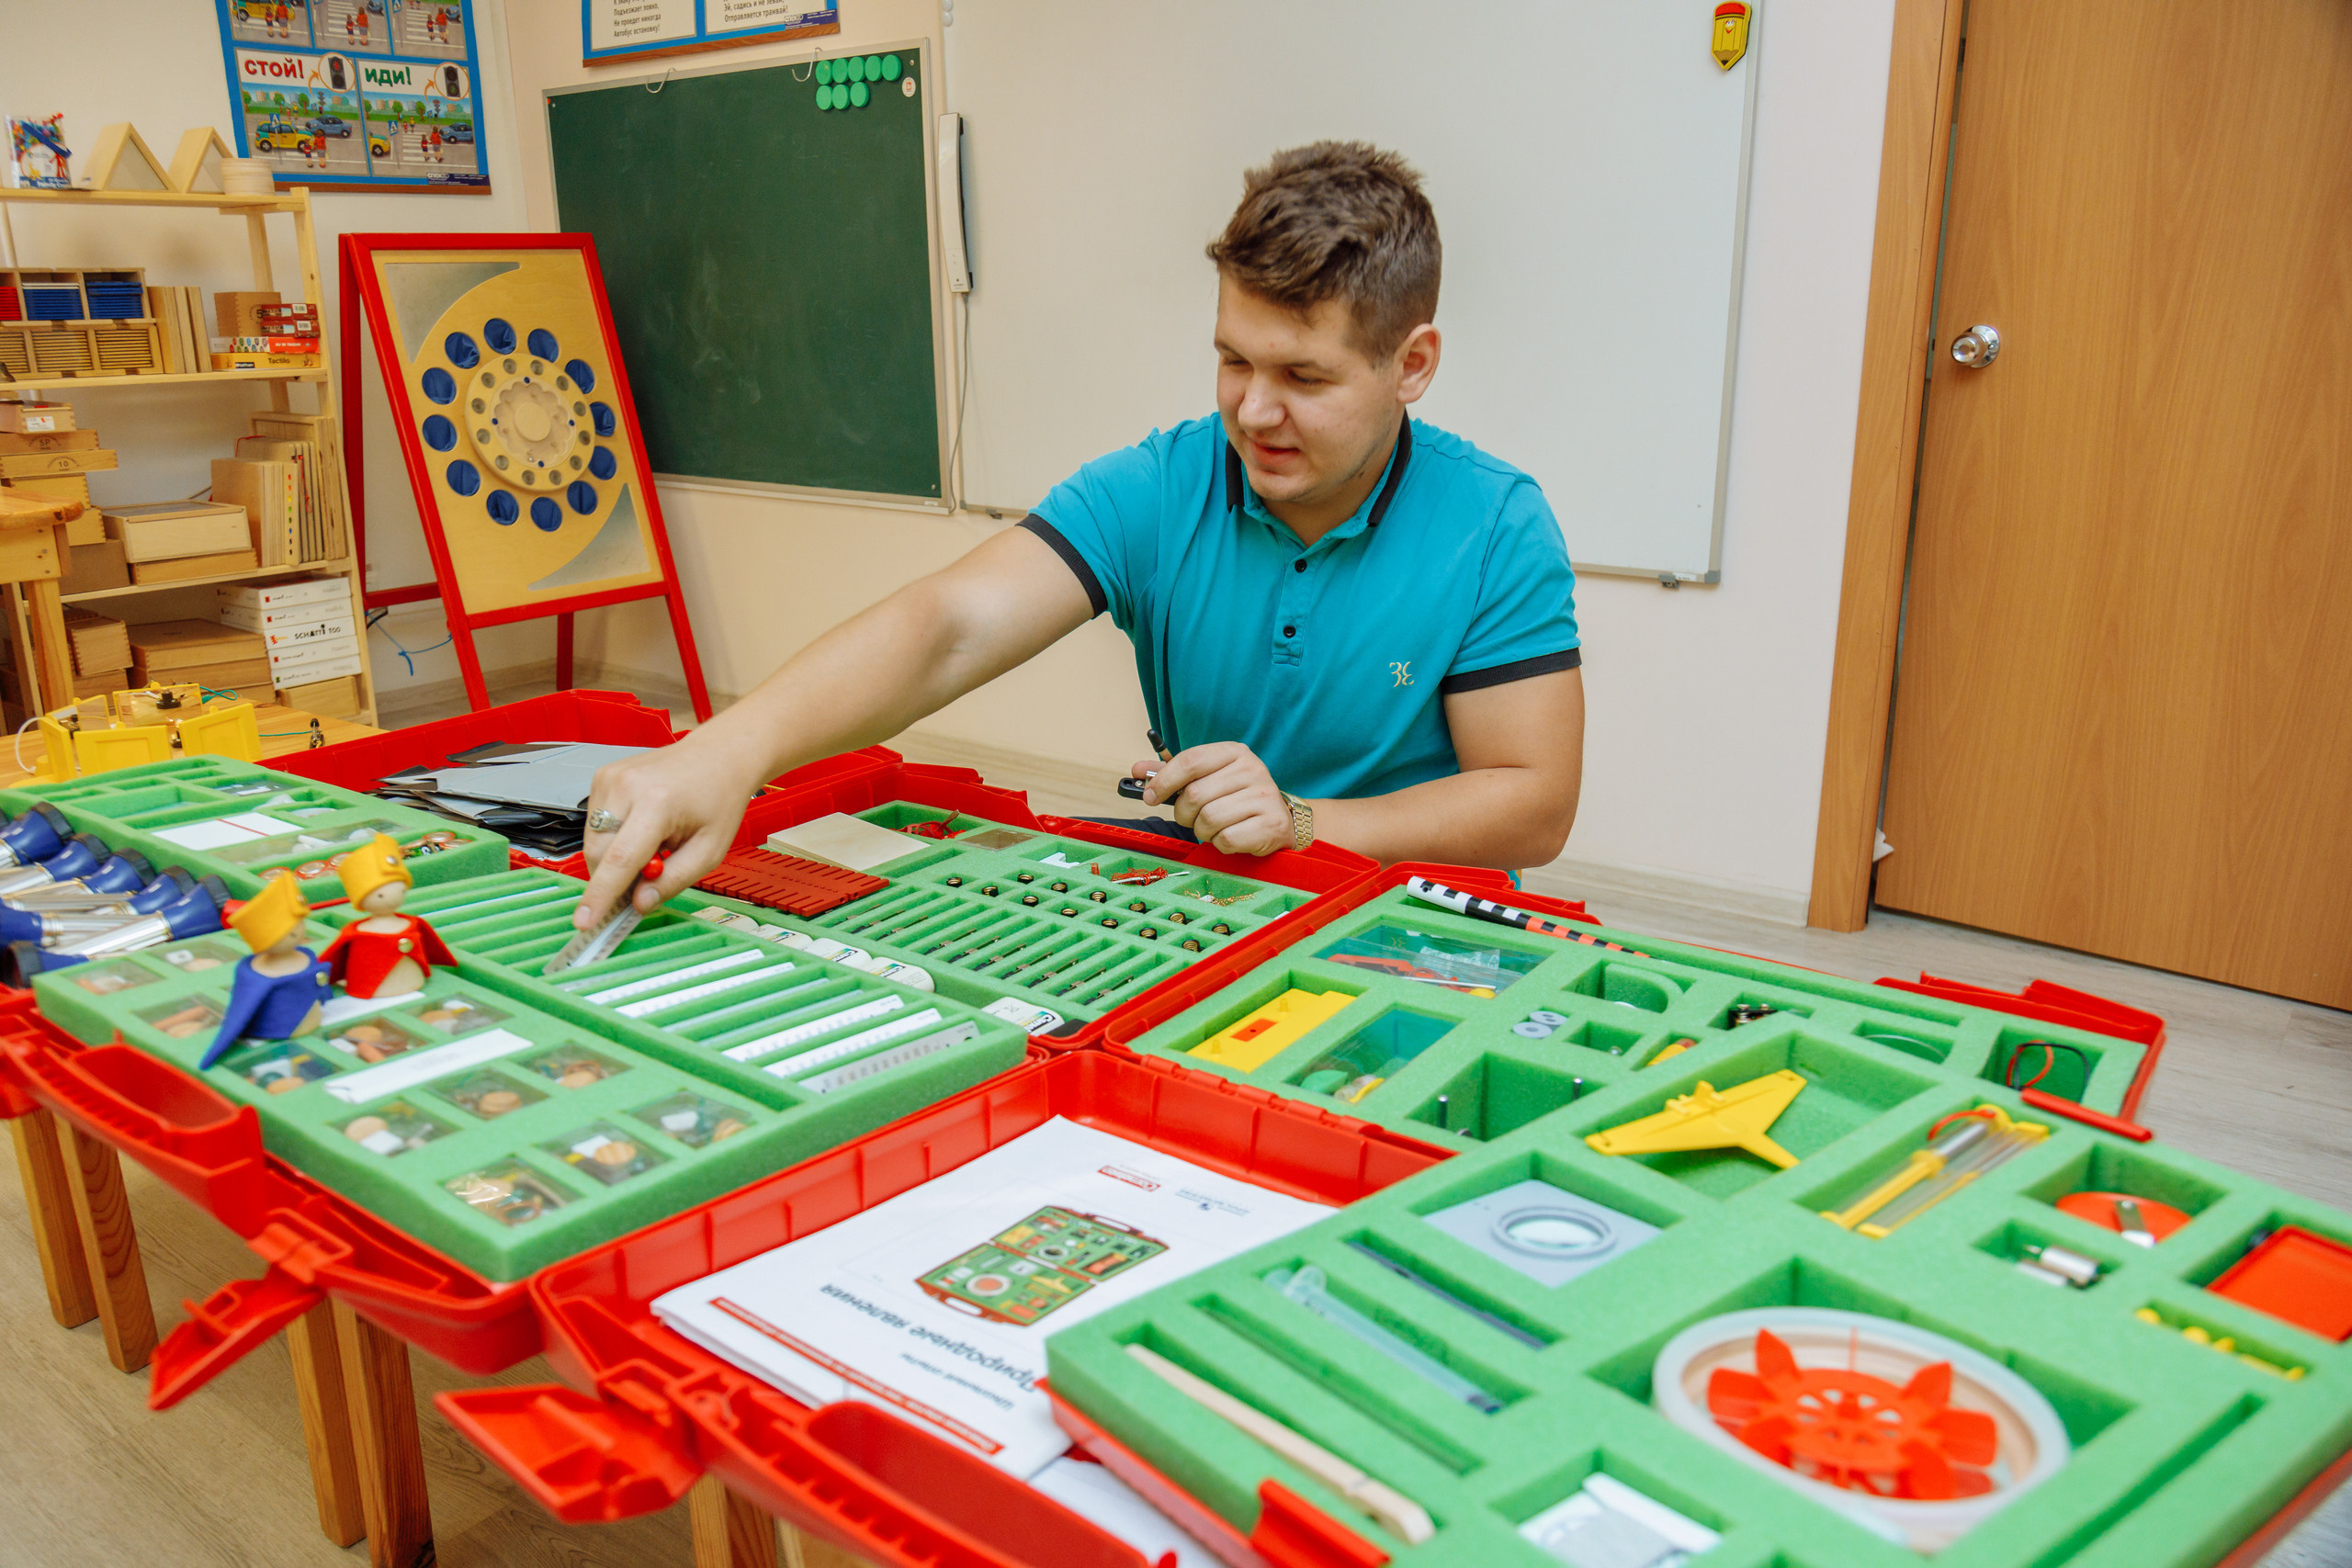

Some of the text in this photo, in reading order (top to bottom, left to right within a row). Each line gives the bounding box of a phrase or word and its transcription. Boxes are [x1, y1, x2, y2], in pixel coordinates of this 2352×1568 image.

[724, 9, 762, 23] Отправляется
[763, 5, 788, 18] трамвай!
[613, 28, 633, 38] Автобус
[820, 1283, 910, 1330] явления
